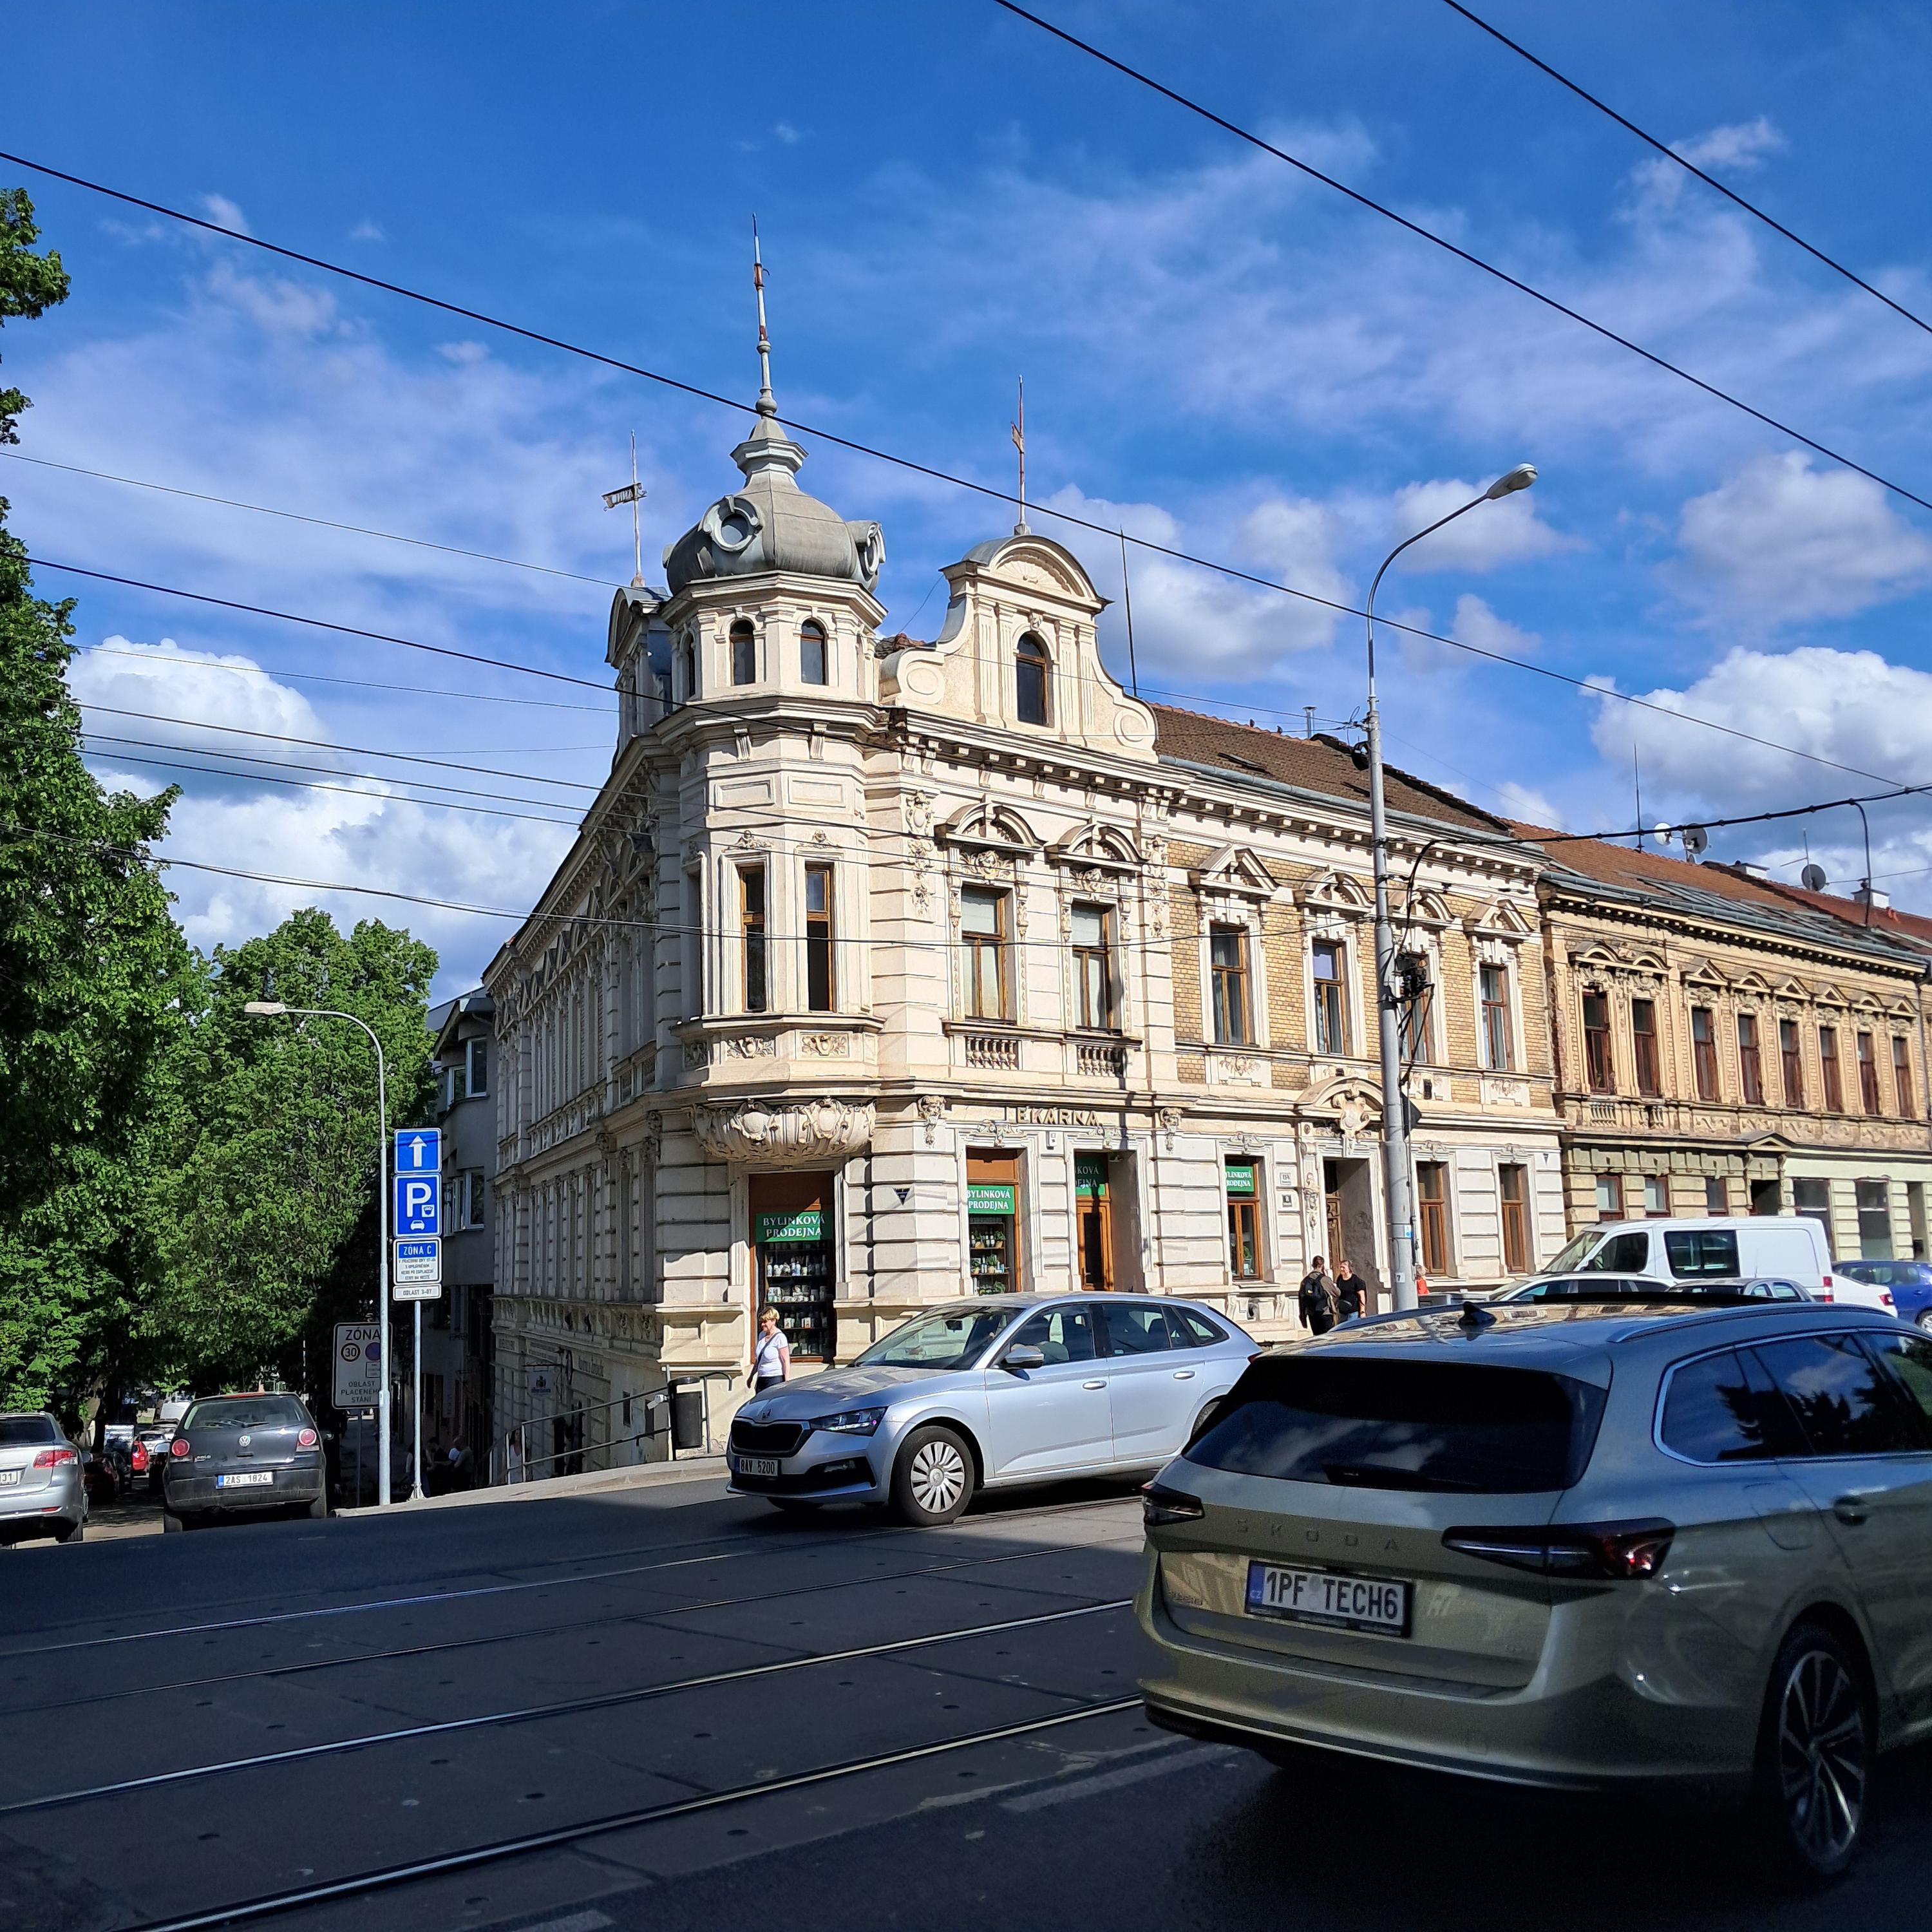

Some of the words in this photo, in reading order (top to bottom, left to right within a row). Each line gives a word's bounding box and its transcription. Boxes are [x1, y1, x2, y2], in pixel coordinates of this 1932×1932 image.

[967, 1188, 1010, 1198] BYLINKOVÁ
[407, 1182, 431, 1217] P
[969, 1200, 1009, 1211] PRODEJNA
[763, 1213, 824, 1226] BYLINKOVÁ
[766, 1227, 822, 1237] PRODEJNA
[403, 1244, 424, 1255] ZÓNA
[427, 1245, 431, 1254] C
[346, 1327, 381, 1340] ZÓNA
[345, 1348, 357, 1357] 30
[758, 1460, 775, 1473] 5200
[225, 1476, 241, 1484] 2AS
[1249, 1589, 1262, 1600] CZ
[1267, 1571, 1307, 1605] 1PF
[1323, 1578, 1398, 1619] TECH6
